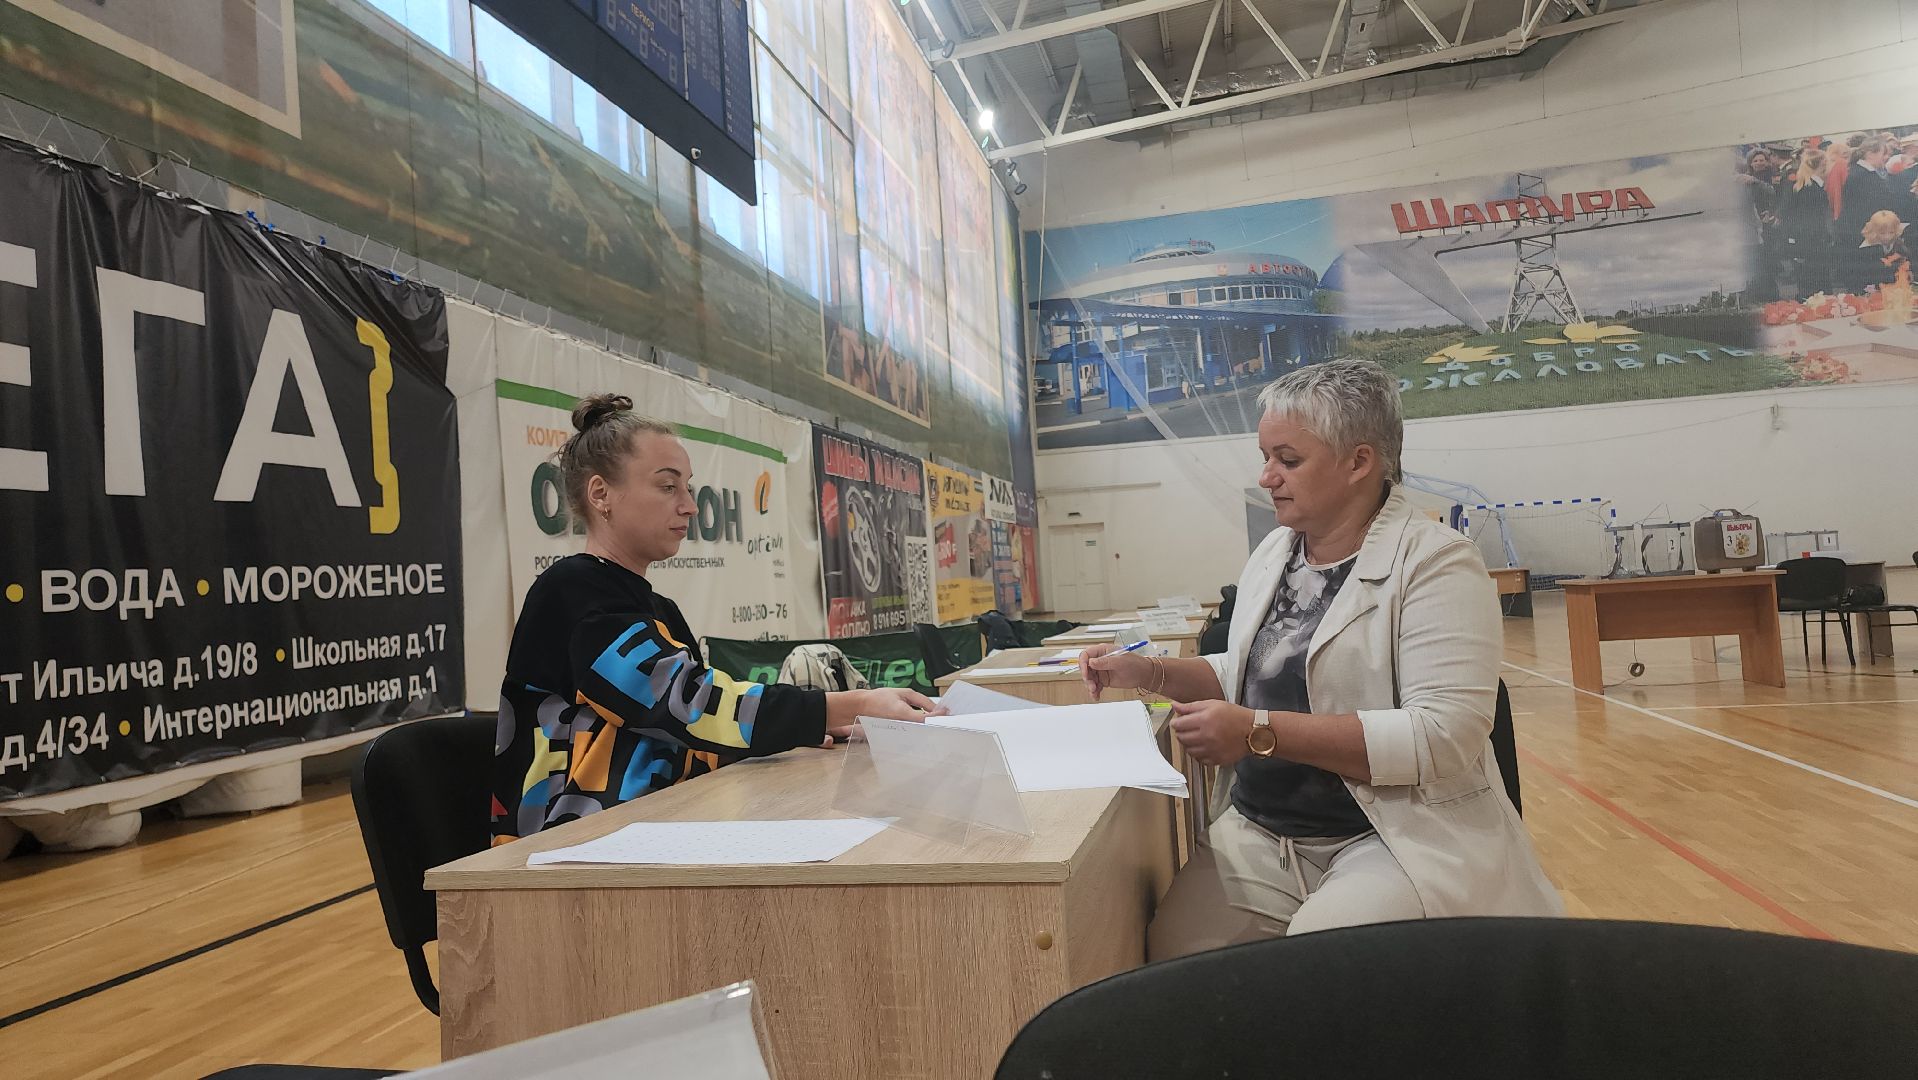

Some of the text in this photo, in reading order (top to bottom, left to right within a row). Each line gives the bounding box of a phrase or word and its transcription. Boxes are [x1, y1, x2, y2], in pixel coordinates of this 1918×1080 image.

[41, 563, 446, 620] ВОДА МОРОЖЕНОЕ
[33, 658, 164, 701] Ильича
[174, 641, 258, 690] д.19/8
[291, 623, 447, 670] Школьная д.17
[0, 665, 437, 775] д.4/34 Интернациональная д.1
